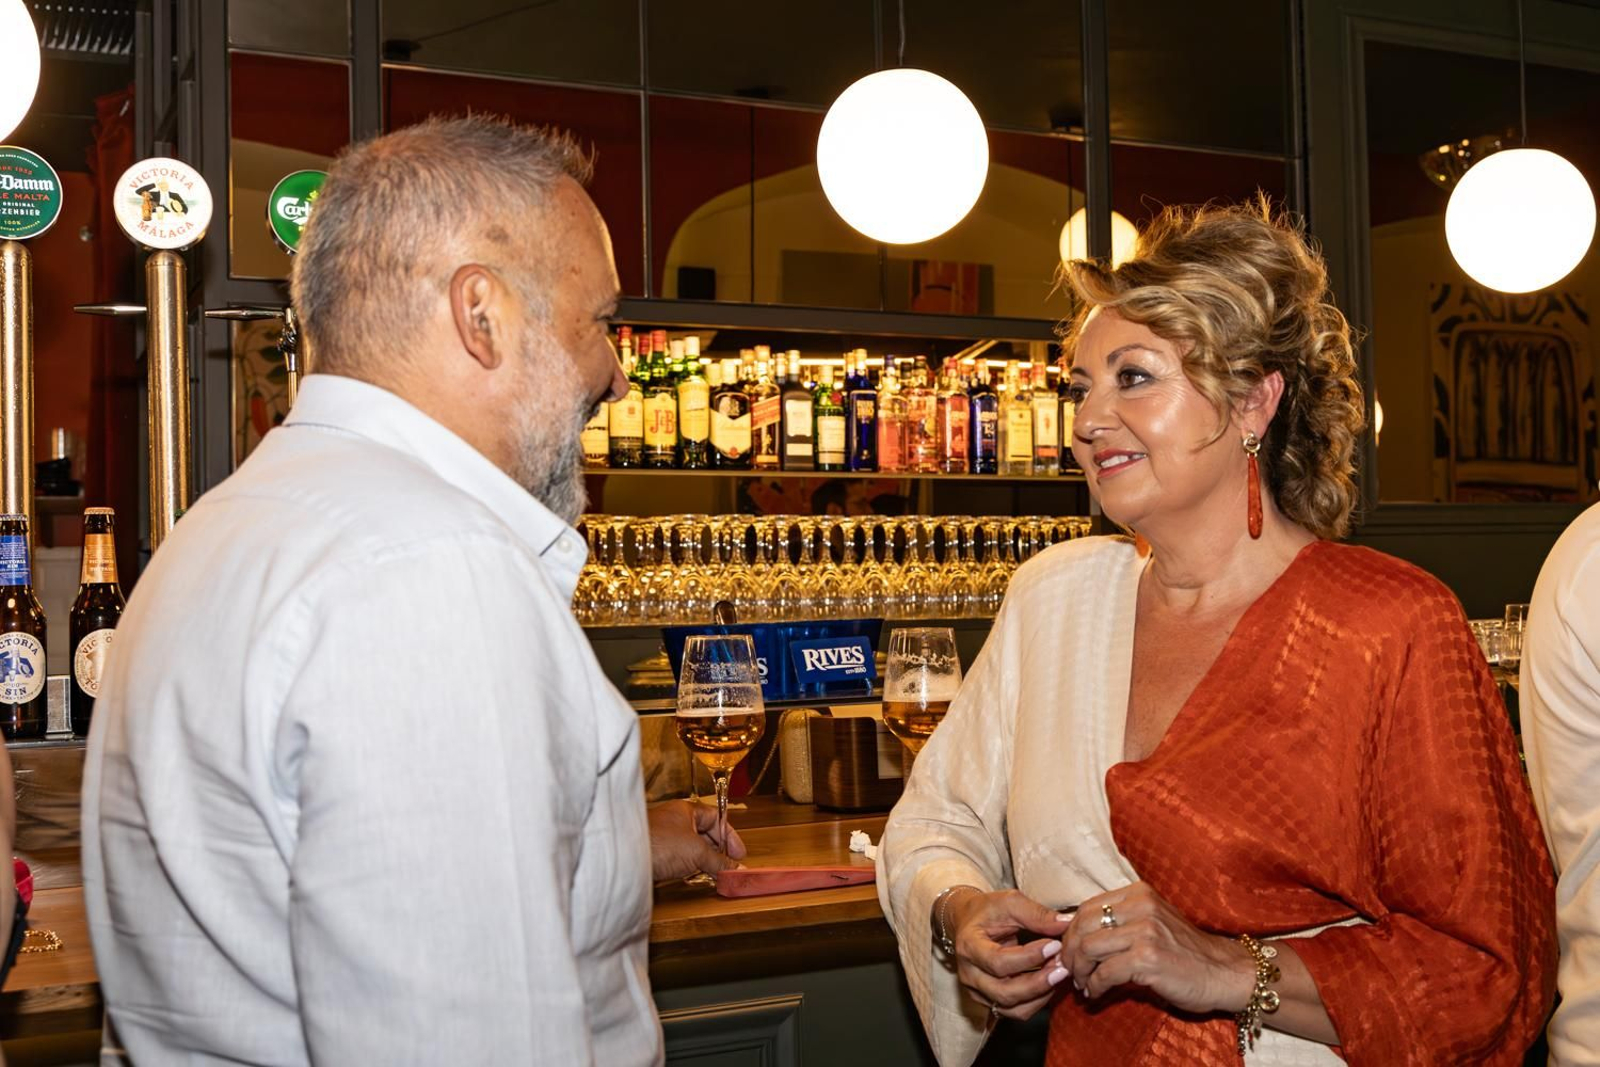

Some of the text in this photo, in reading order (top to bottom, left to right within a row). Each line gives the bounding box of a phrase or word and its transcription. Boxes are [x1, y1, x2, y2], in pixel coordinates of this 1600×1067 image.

[129, 167, 194, 190] VICTORIA
[14, 192, 50, 201] MALTA
[0, 207, 41, 216] ZENBIER
[276, 196, 311, 221] Carl
[82, 636, 112, 654] VICO
[756, 657, 769, 676] S
[802, 645, 865, 671] RIVES
[4, 687, 27, 696] SIN
[85, 679, 98, 690] TO
